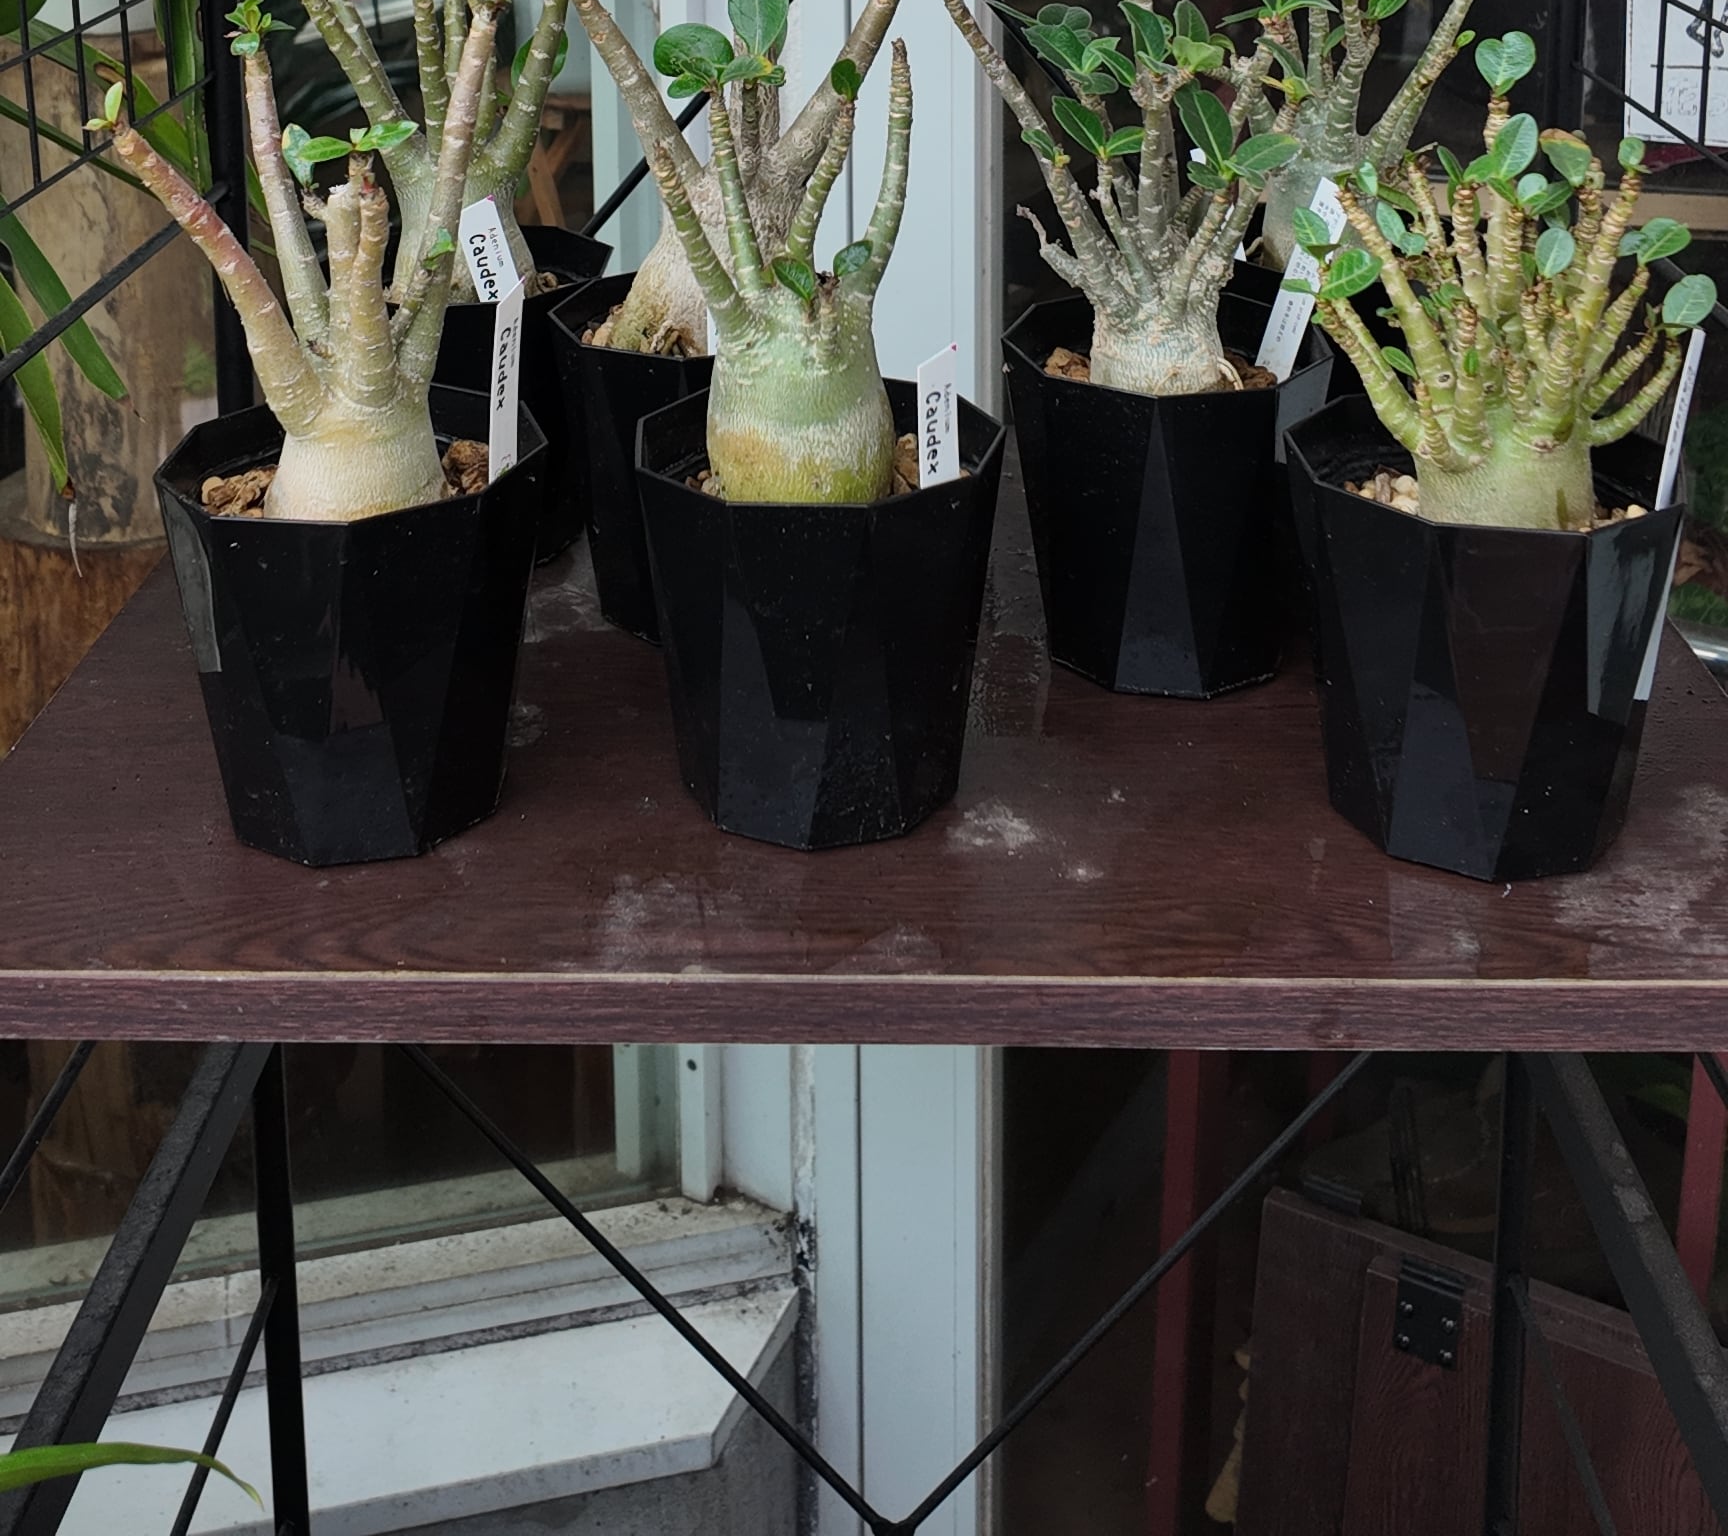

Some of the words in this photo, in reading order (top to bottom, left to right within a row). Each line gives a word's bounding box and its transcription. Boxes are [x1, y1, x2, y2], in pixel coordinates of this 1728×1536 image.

[469, 233, 499, 300] Caudex
[496, 327, 512, 411] Caudex
[926, 391, 941, 475] Caudex
